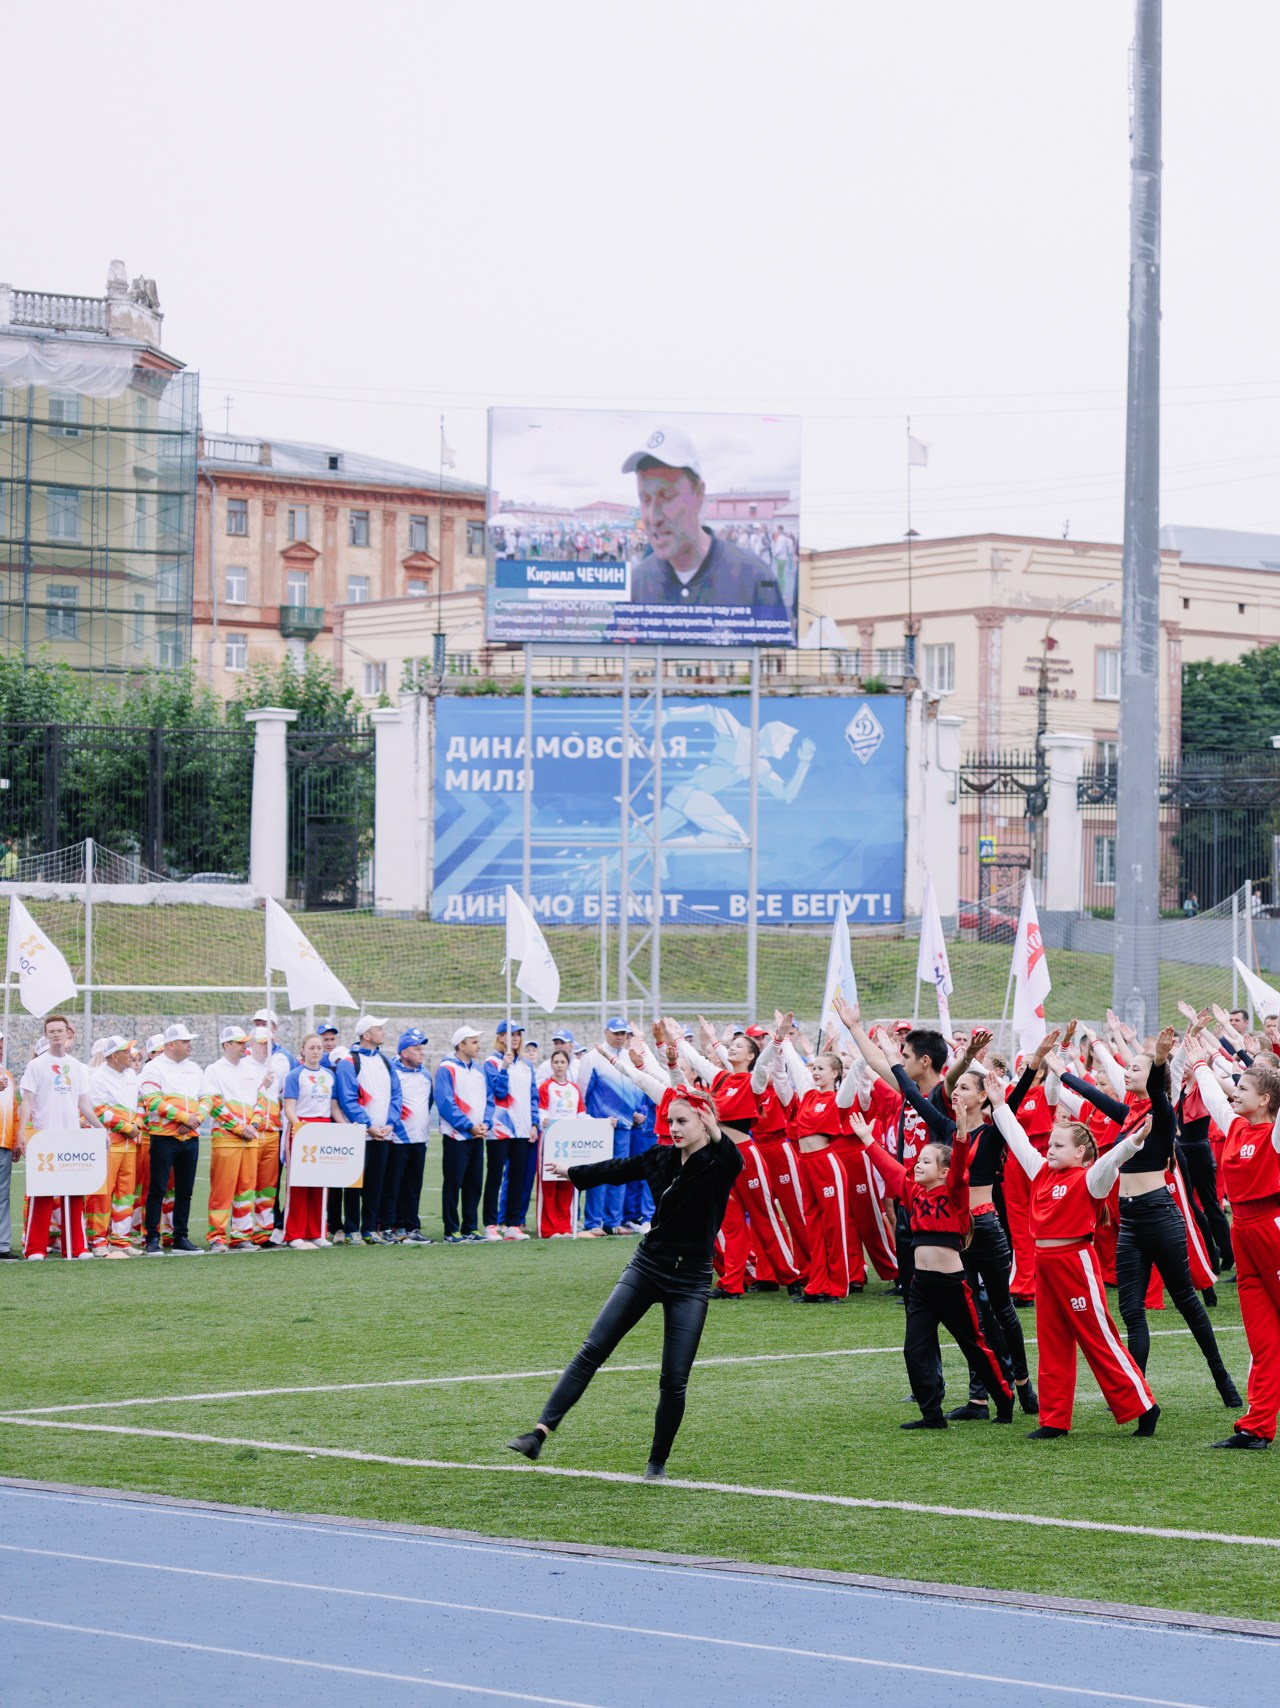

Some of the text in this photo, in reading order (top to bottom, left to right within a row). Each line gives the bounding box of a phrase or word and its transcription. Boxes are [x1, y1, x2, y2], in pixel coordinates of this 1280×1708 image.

[526, 566, 625, 585] Кирилл ЧЕЧИН
[445, 736, 687, 762] ДИНАМОВСКАЯ
[445, 769, 534, 792] МИЛЯ
[443, 894, 575, 921] ДИНМО
[729, 894, 783, 917] ВСЕ
[792, 893, 892, 917] БЕГУТ!
[571, 1140, 604, 1149] КОМОС
[1240, 1144, 1255, 1156] 20
[320, 1145, 355, 1156] КОМОС
[57, 1152, 96, 1162] КОМОС
[748, 1178, 760, 1187] 20
[779, 1174, 791, 1182] 20
[823, 1186, 835, 1196] 20
[855, 1184, 867, 1193] 20
[1052, 1185, 1067, 1197] 20
[1071, 1297, 1087, 1309] 20
